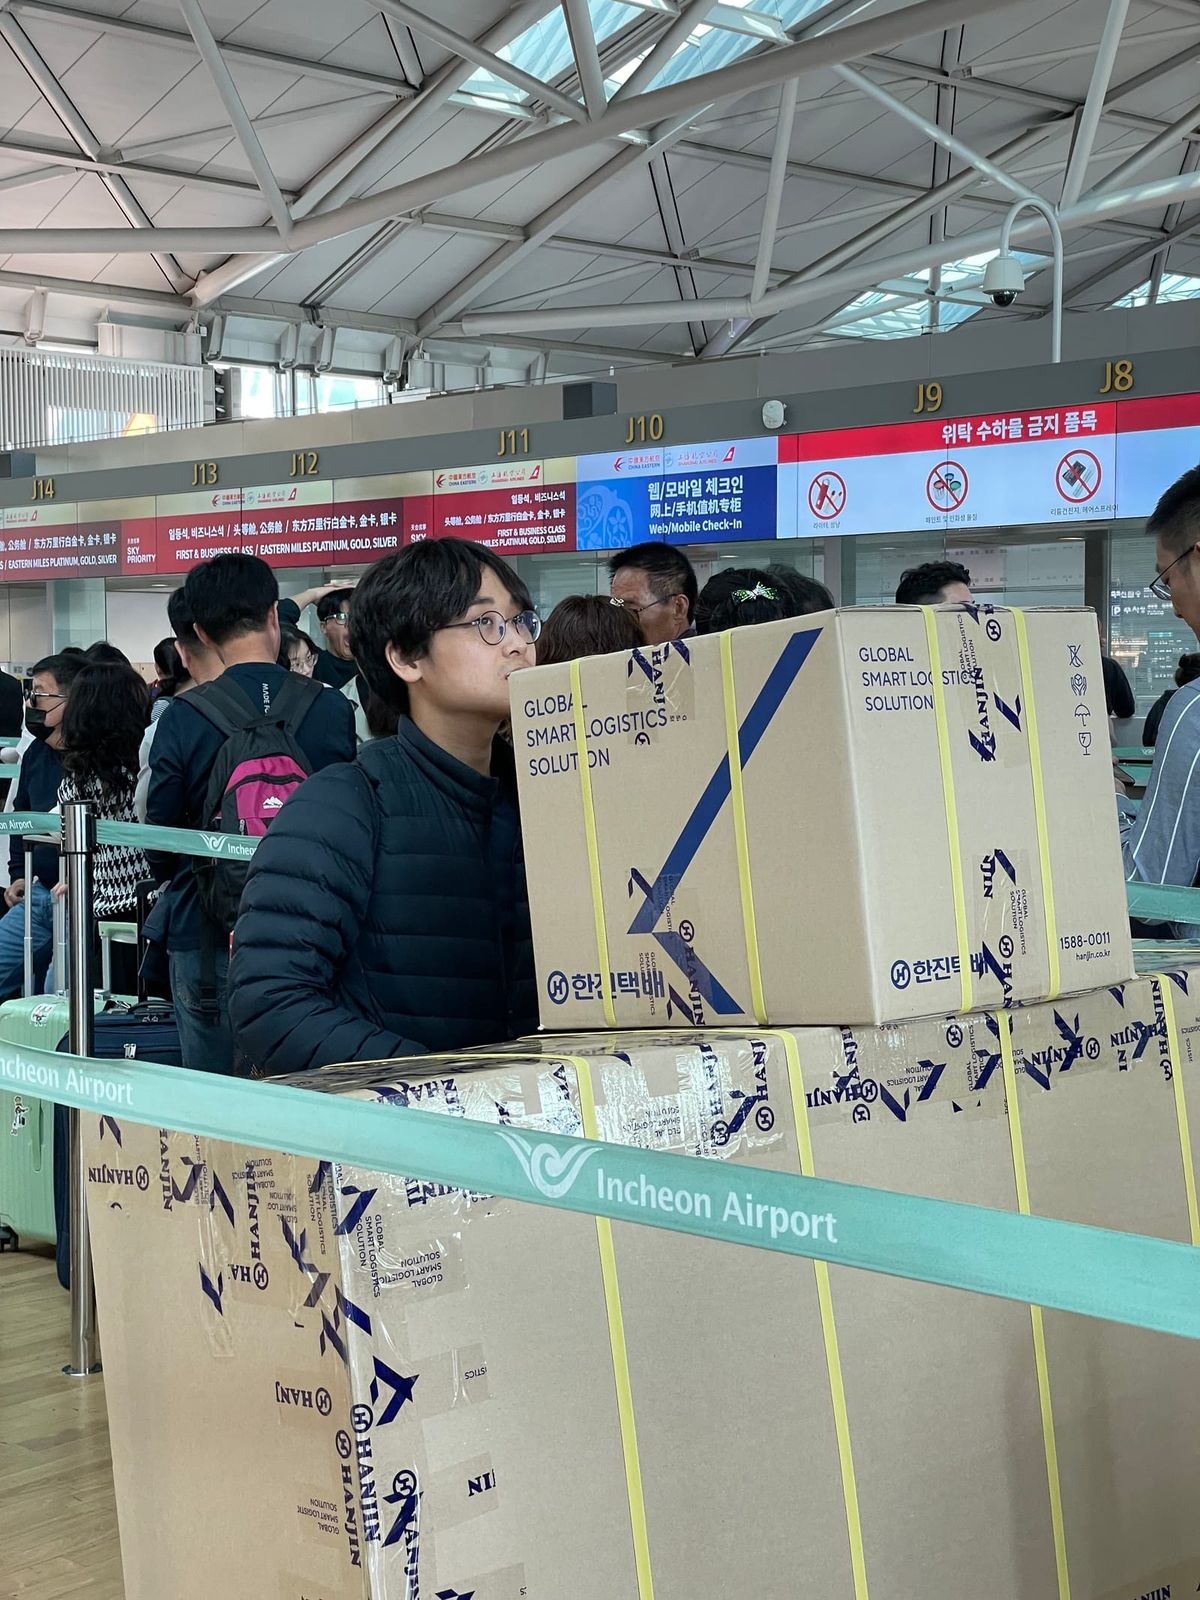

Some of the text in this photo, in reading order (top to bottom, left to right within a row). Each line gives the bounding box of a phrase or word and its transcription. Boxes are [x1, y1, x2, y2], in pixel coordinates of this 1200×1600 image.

[1099, 360, 1133, 393] J8
[912, 382, 944, 414] J9
[625, 414, 664, 443] J10
[942, 410, 1098, 444] 위탁 수하물 금지 품목
[497, 428, 529, 456] J11
[191, 463, 218, 486] J13
[290, 452, 319, 476] J12
[32, 479, 55, 500] J14
[648, 475, 743, 500] 웹/모바일 체크인
[650, 498, 742, 518] 网上/手机值机专柜
[191, 525, 224, 539] 비즈니스석
[497, 528, 514, 538] FIRST
[518, 525, 547, 536] BUSINESS
[547, 524, 566, 534] CLASS
[649, 518, 742, 535] Web/Mobile Check-In
[176, 549, 194, 560] FIRST
[260, 542, 290, 556] EASTERN
[291, 542, 313, 553] MILES
[313, 540, 349, 552] PLATINUM,
[373, 536, 397, 549] SILVER
[411, 533, 427, 543] SKY
[546, 533, 566, 543] SILVER
[8, 558, 33, 569] EASTERN
[33, 557, 49, 568] MILES
[98, 554, 117, 565] SILVER
[127, 546, 139, 555] SKY
[127, 553, 157, 564] PRIORITY
[859, 647, 915, 662] GLOBAL
[862, 669, 979, 687] SMART LOGSTICS
[262, 682, 270, 704] MADE
[865, 695, 934, 711] SOLUTION
[526, 708, 667, 747] SMART OGISTICS
[529, 748, 610, 776] SOLUTON
[10, 819, 33, 830] Airport
[228, 842, 257, 857] Incheo
[1009, 890, 1018, 929] SOLUTION
[1060, 932, 1111, 950] 1588-0011
[1075, 950, 1111, 961] hanjin.co.kr
[571, 970, 665, 1001] 한진택배
[66, 1067, 135, 1105] Airport
[88, 1163, 134, 1185] HANJIN
[246, 1164, 261, 1260] HANJIN
[597, 1168, 839, 1245] Incheon Airport
[365, 1216, 375, 1247] SMART
[375, 1214, 385, 1252] GLOBAL
[401, 1251, 441, 1268] SOLUTION
[416, 1262, 442, 1276] SMART
[411, 1274, 443, 1288] GLOBAL
[275, 1381, 313, 1409] HANJ
[341, 1463, 361, 1568] HANJIN
